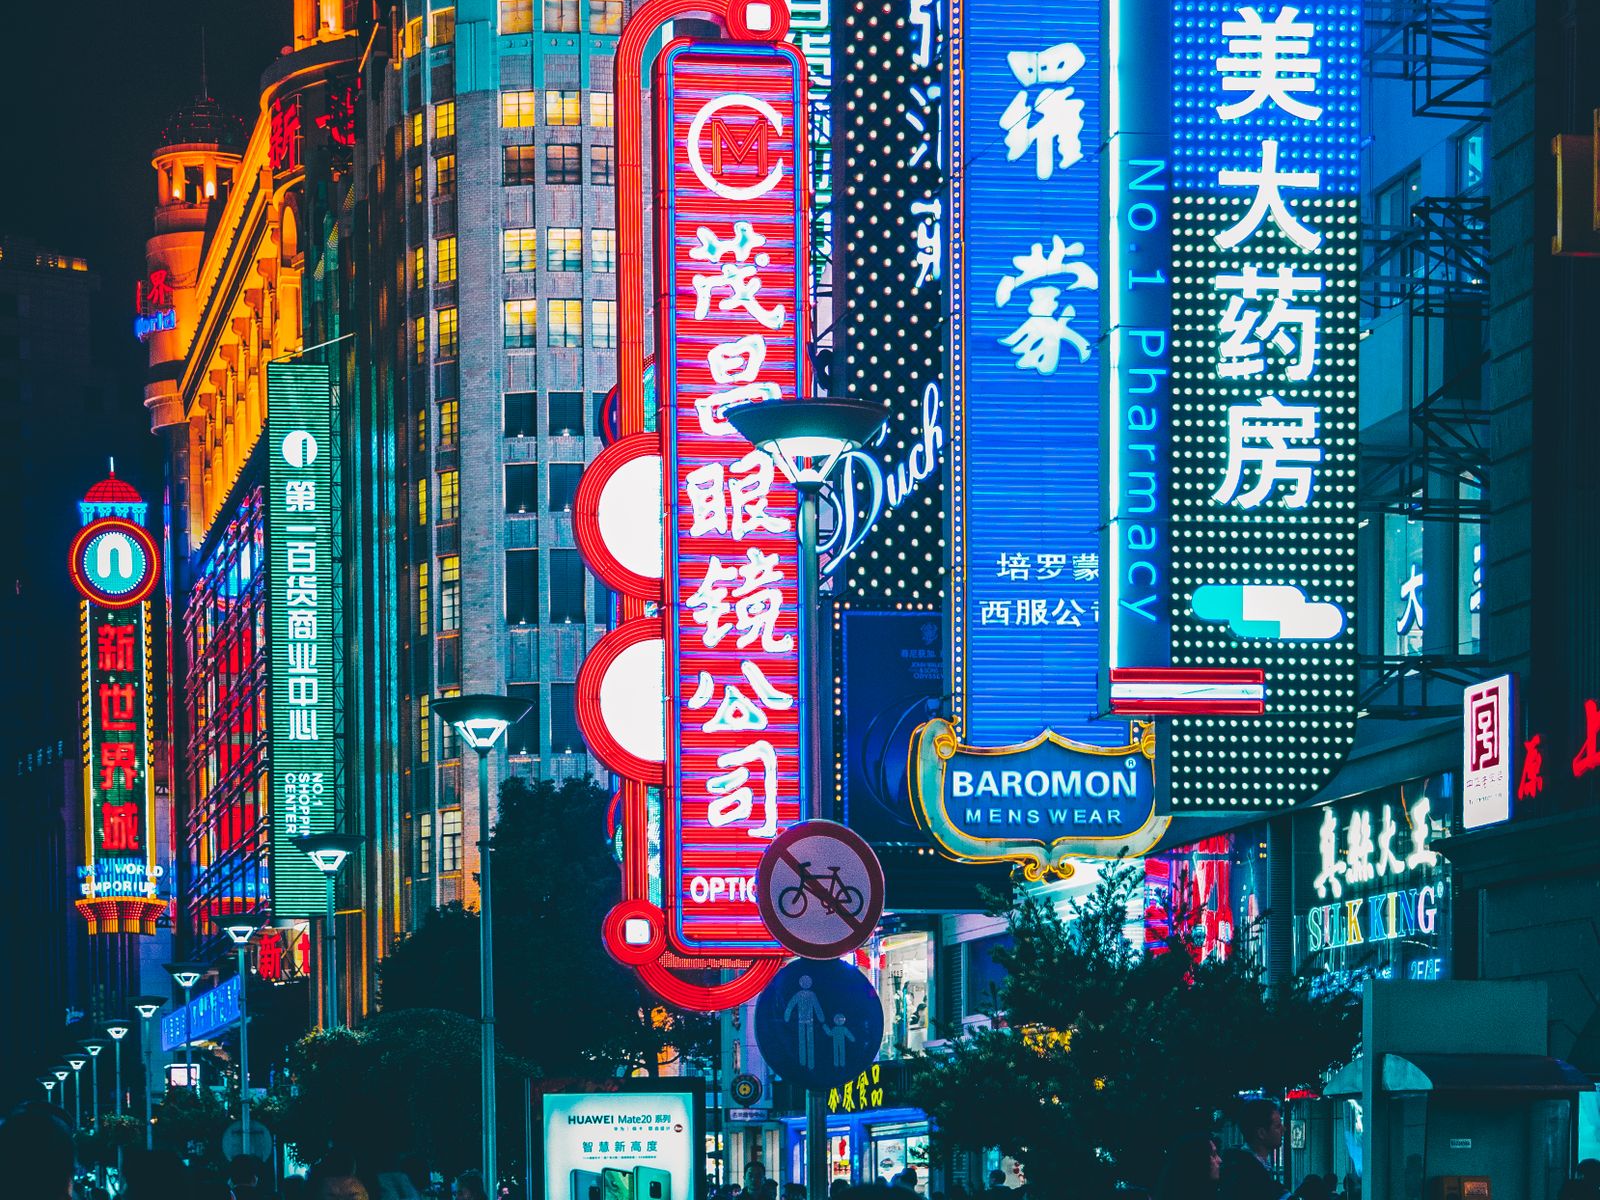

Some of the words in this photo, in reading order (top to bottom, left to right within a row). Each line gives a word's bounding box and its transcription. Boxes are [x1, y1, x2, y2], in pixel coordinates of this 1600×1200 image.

[1127, 158, 1167, 290] No.1
[1120, 329, 1167, 622] Pharmacy
[996, 551, 1099, 581] 培罗蒙
[285, 480, 319, 741] 第一百货商业中心
[97, 623, 140, 851] 新世界城
[284, 773, 297, 835] CENTER
[951, 768, 1138, 799] BAROMON
[965, 808, 1040, 825] MENS
[1048, 808, 1122, 825] WEAR
[114, 862, 164, 877] WORLD
[1308, 898, 1364, 952] SILK
[1367, 886, 1438, 942] KING
[568, 1115, 614, 1125] HUAWEI
[618, 1115, 652, 1124] Mate20
[582, 1141, 658, 1153] 智慧新高度
